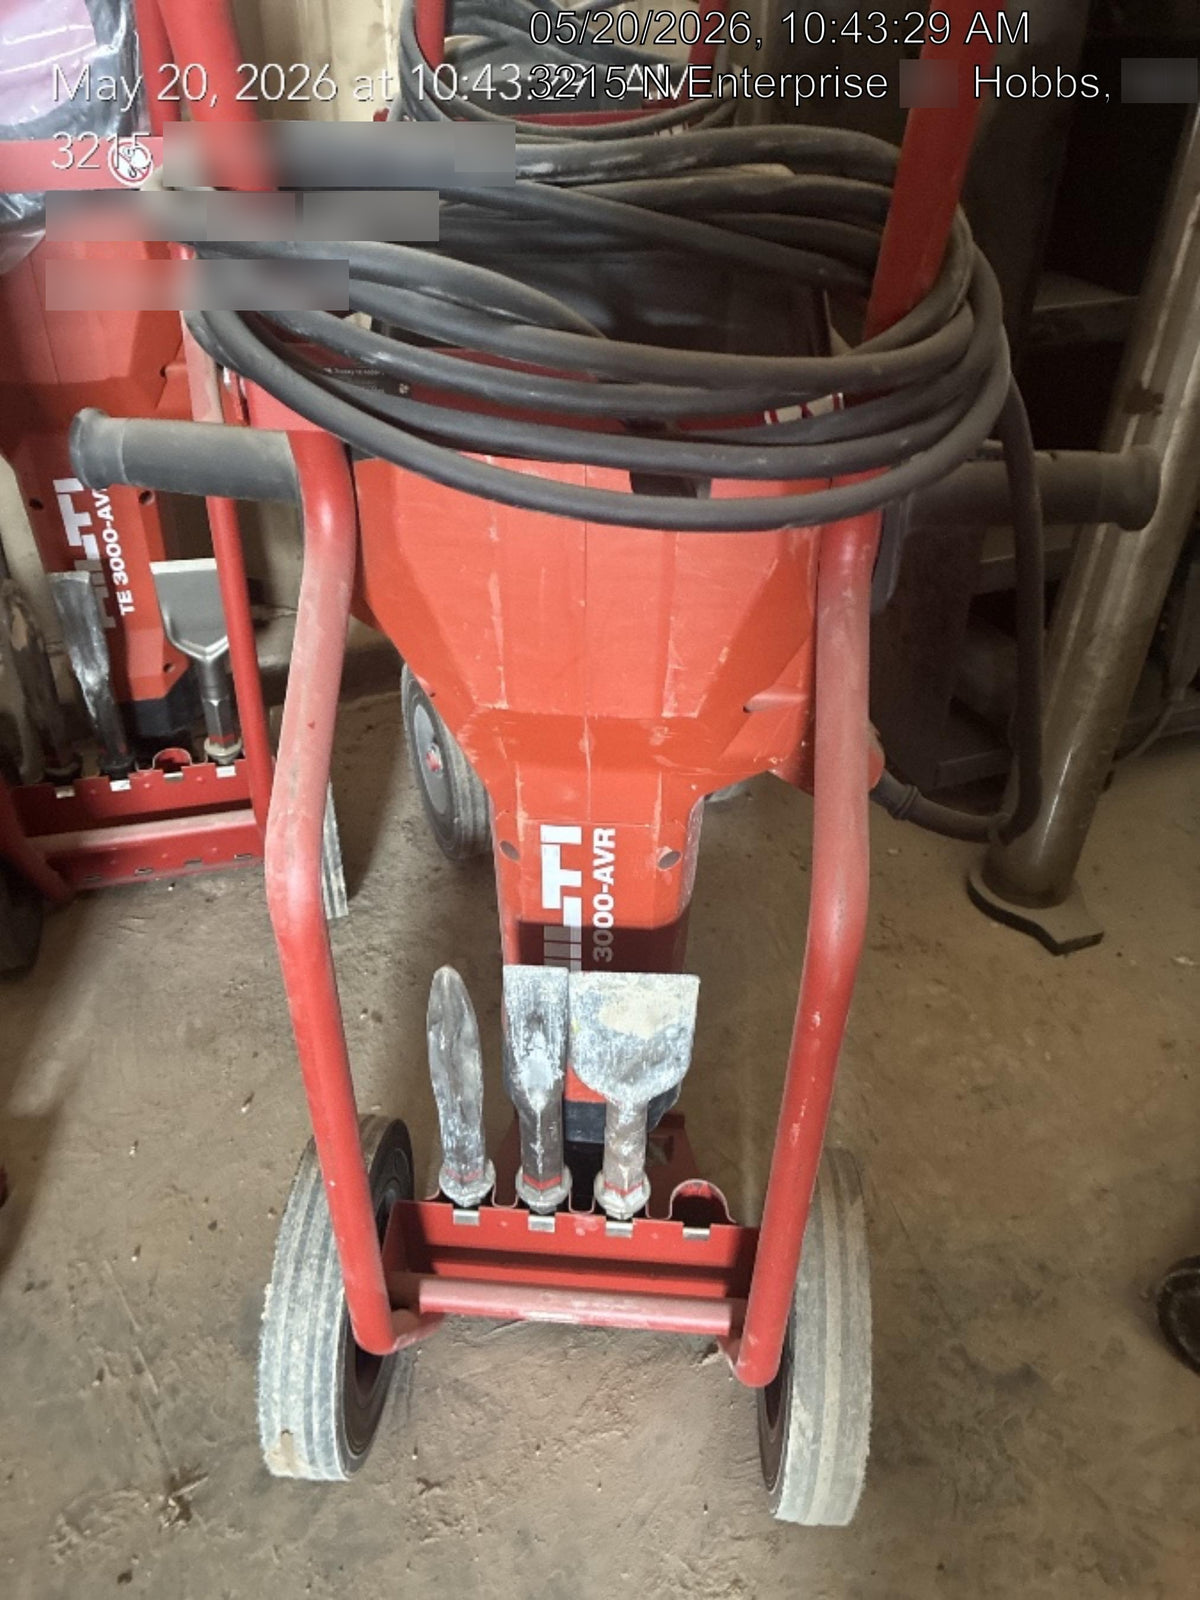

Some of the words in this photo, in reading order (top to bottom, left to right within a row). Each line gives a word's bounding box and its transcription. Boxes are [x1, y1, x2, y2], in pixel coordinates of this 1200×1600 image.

[92, 487, 129, 587] 3000-AV
[117, 589, 136, 617] TE
[541, 824, 583, 972] ILTI
[592, 827, 616, 963] 3000-AVR
